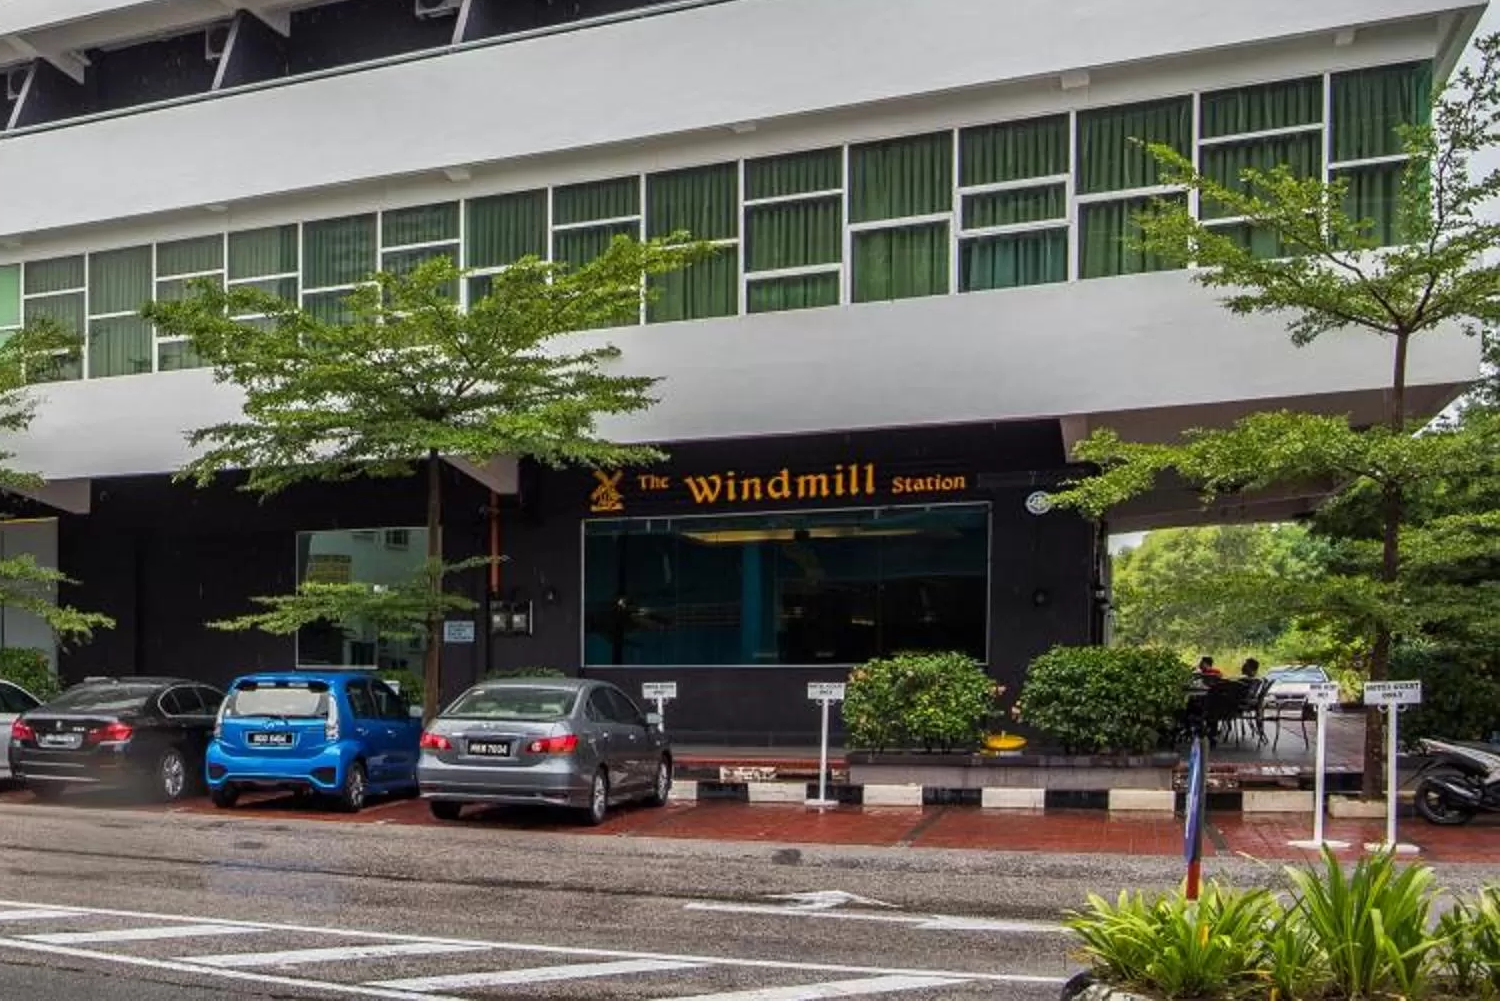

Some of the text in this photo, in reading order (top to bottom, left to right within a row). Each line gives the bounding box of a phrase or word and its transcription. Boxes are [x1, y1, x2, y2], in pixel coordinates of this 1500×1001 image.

[638, 463, 966, 504] The Windmill Station
